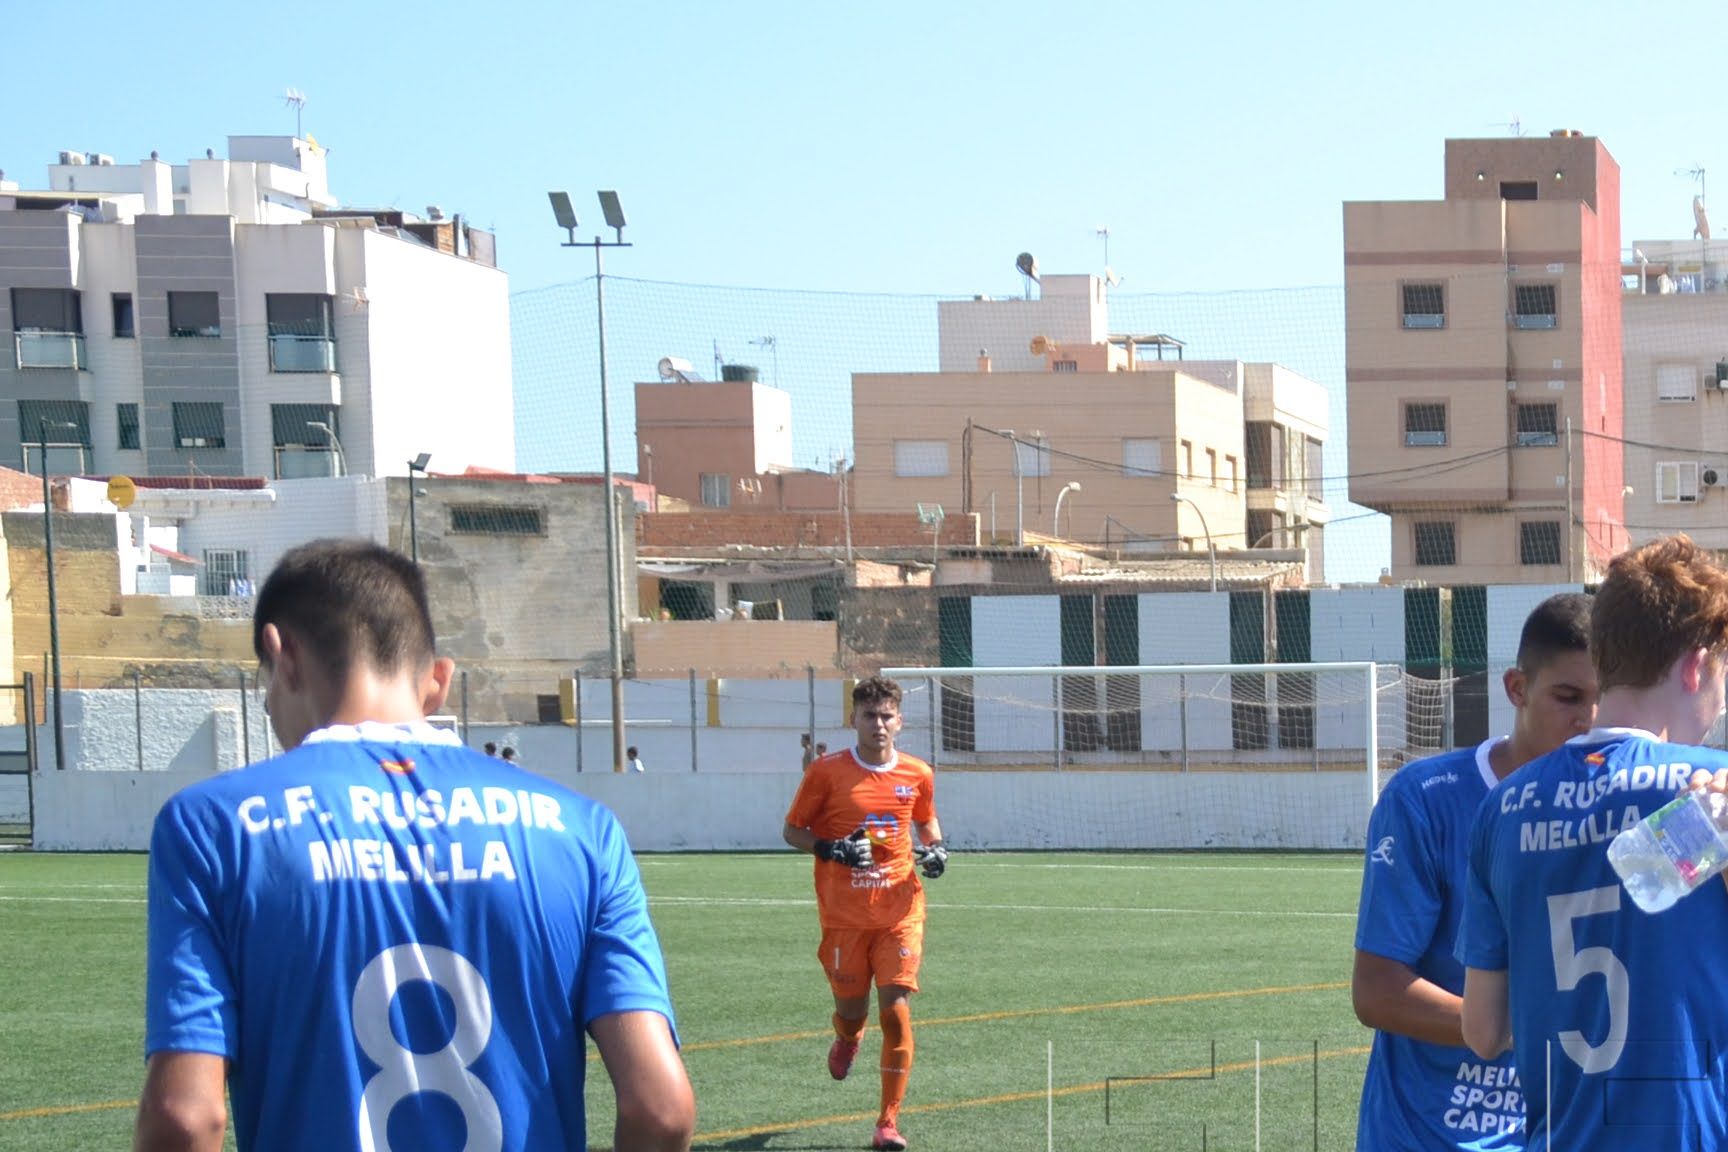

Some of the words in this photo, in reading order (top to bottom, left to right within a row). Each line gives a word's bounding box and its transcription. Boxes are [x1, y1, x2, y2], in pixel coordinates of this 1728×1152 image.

[237, 785, 333, 833] C.F.
[348, 785, 566, 832] RUSADIR
[1500, 781, 1543, 815] C.F.
[1553, 762, 1693, 809] RUSADIR
[1519, 805, 1642, 853] MELILLA
[308, 838, 517, 883] MELILLA
[1547, 885, 1629, 1075] 5
[1456, 1062, 1521, 1088] MELI
[1443, 1108, 1527, 1134] CAPIT
